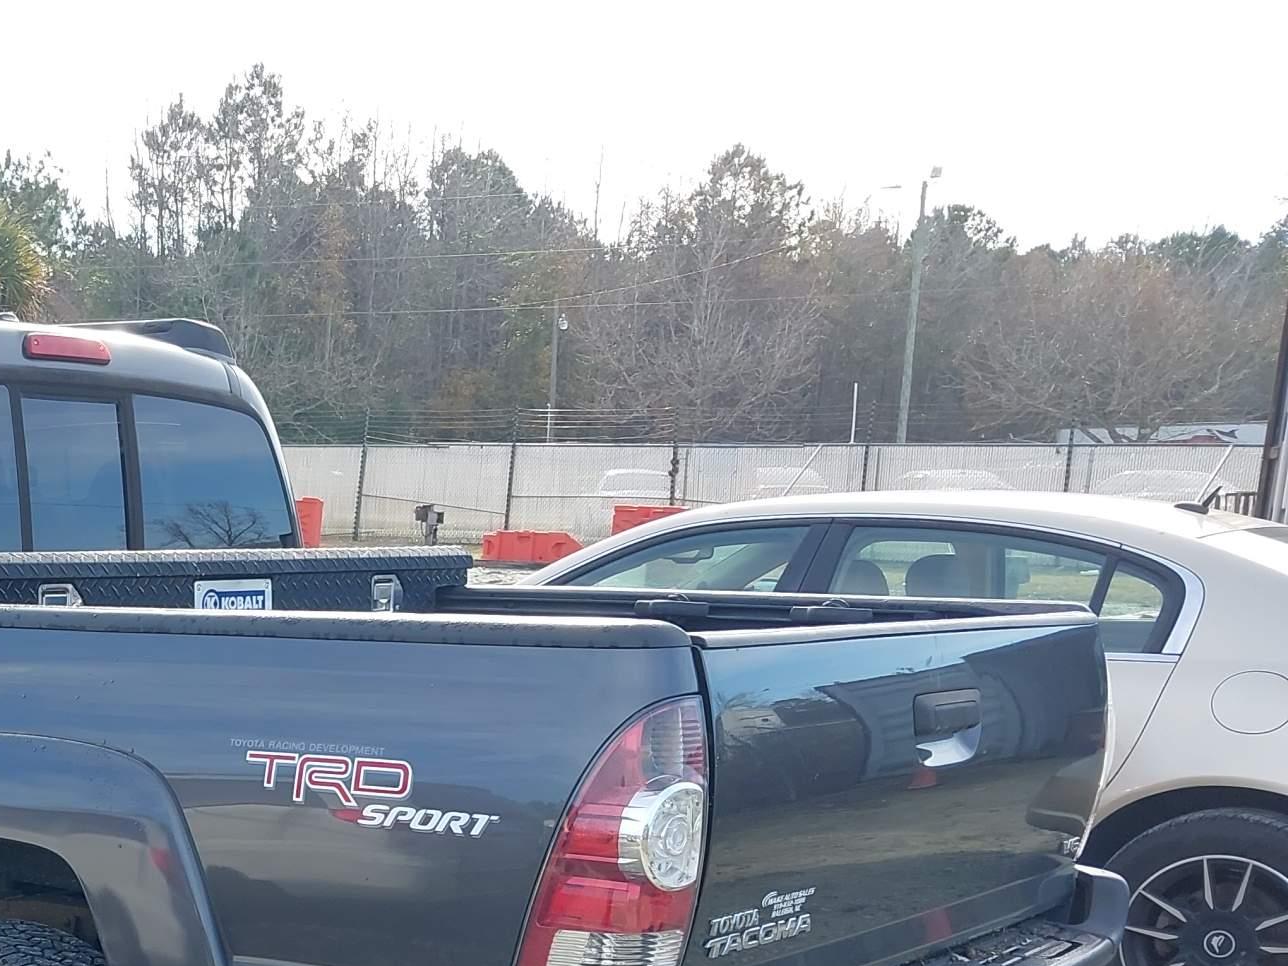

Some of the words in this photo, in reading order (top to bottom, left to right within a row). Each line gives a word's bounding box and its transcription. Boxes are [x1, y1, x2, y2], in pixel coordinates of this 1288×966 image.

[221, 595, 264, 610] KOBALT
[229, 738, 264, 749] TOYOTA
[268, 741, 305, 752] RACING
[309, 743, 385, 757] DEVELOPMENT
[246, 751, 413, 807] TRD
[358, 805, 500, 837] SPORT
[704, 913, 811, 958] TACOMA
[710, 909, 760, 937] TOYOTA
